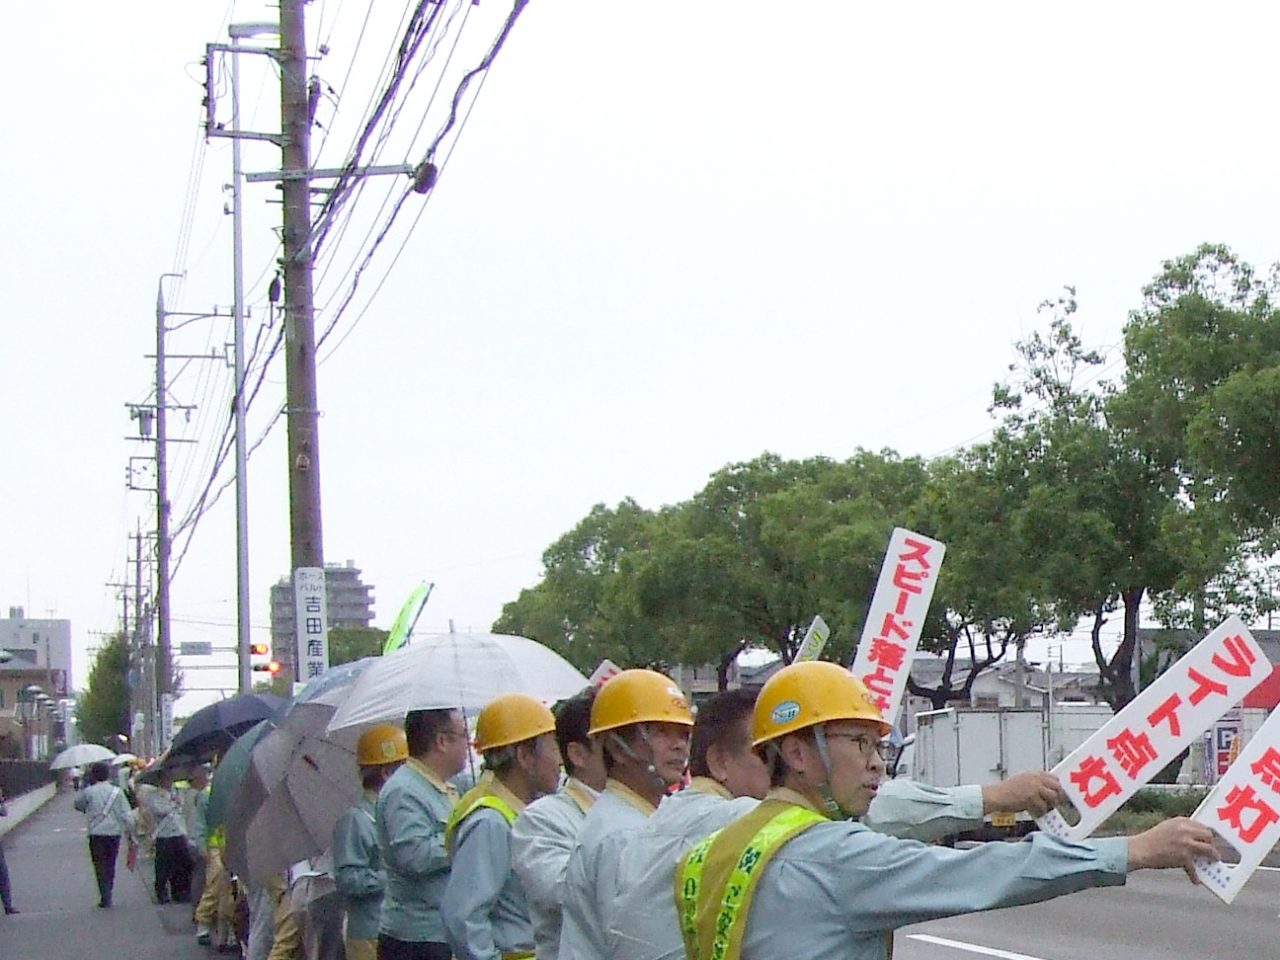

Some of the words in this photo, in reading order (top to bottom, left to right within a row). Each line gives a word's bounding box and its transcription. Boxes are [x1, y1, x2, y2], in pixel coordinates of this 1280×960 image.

[306, 595, 324, 679] 吉田産業
[1069, 633, 1258, 810] ライト点灯
